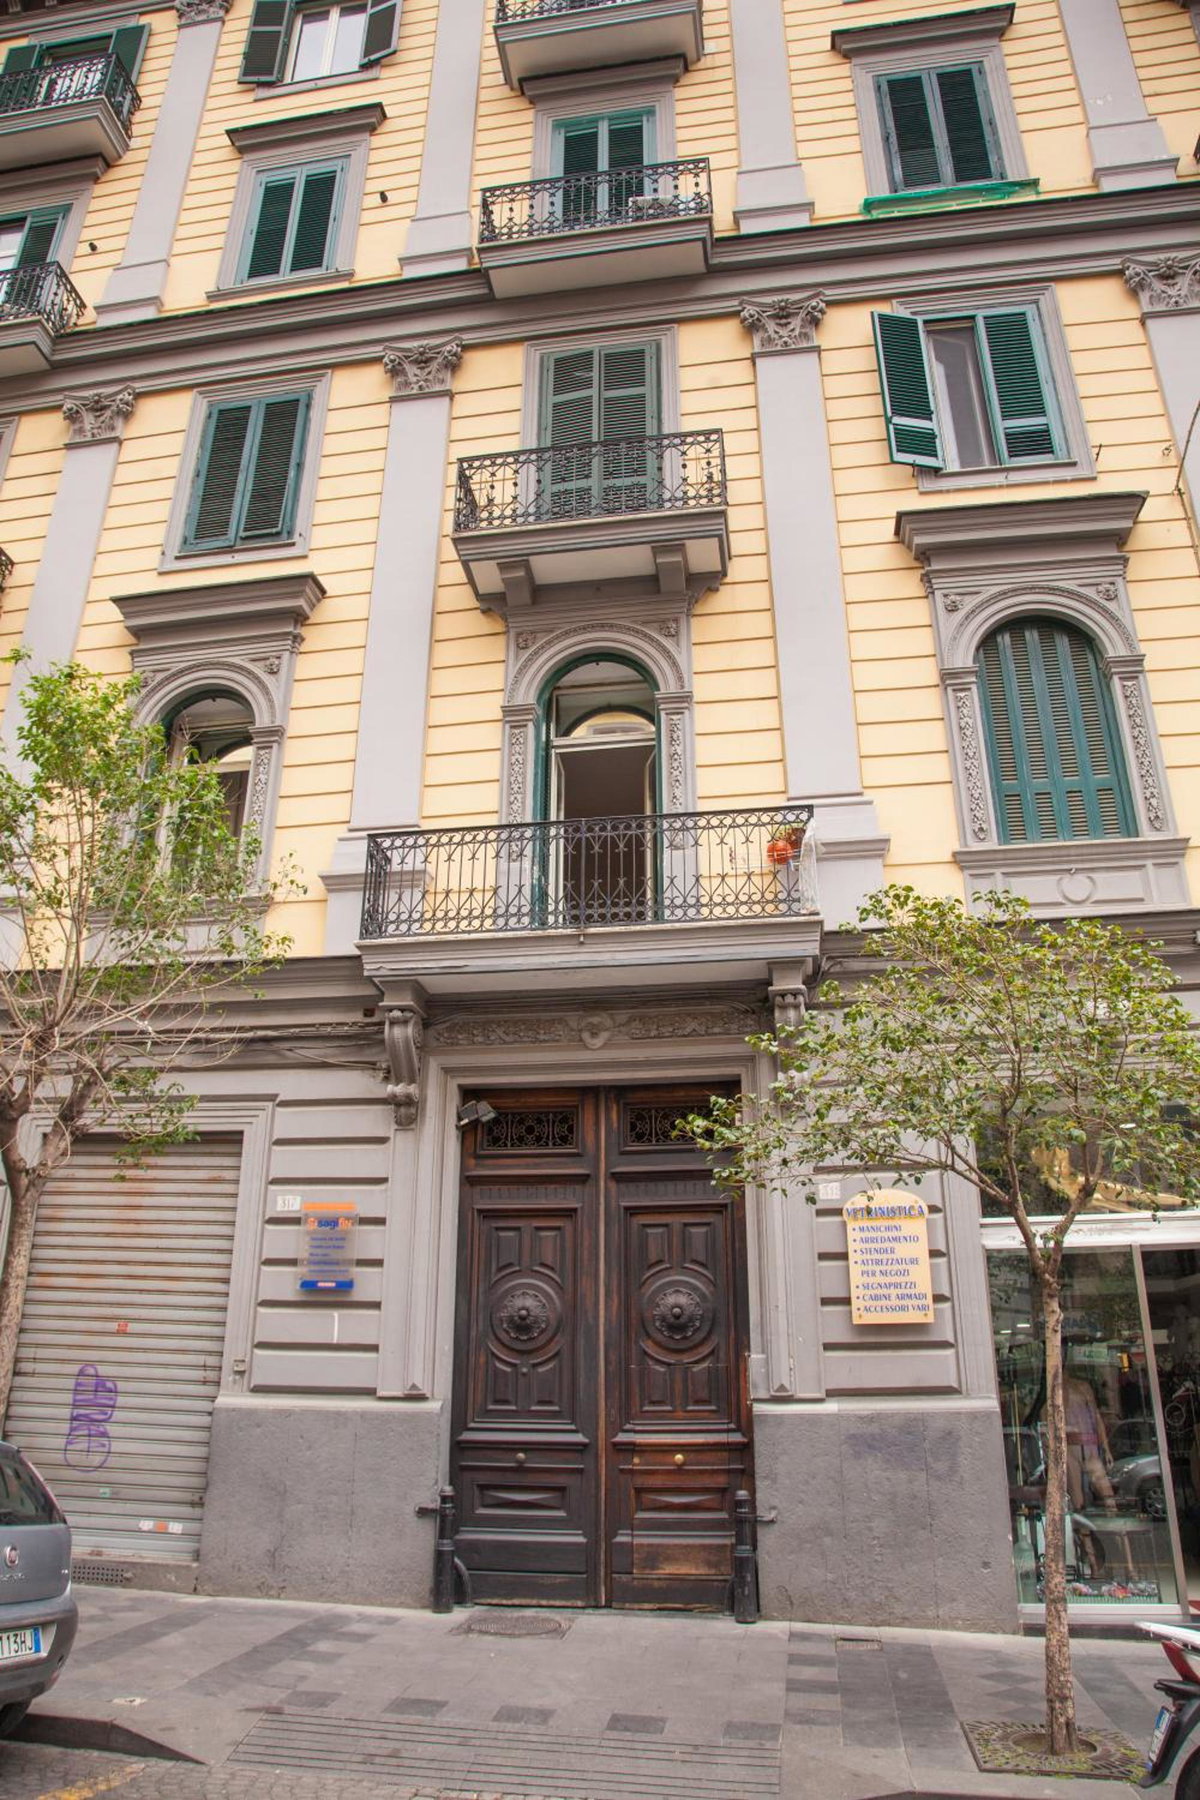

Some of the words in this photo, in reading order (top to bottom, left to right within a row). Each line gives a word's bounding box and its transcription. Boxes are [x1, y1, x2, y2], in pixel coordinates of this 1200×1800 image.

[846, 1205, 925, 1218] VETRINISTICA
[858, 1224, 902, 1233] MANICHINI
[859, 1235, 919, 1244] ARREDAMENTO
[860, 1246, 896, 1255] STENDER
[860, 1258, 920, 1266] ATTREZZATURE
[861, 1270, 877, 1278] PER
[880, 1269, 910, 1277] NEGOZI
[862, 1282, 917, 1291] SEGNAPREZZI
[862, 1294, 892, 1302] CABINE
[895, 1292, 927, 1301] ARMADI
[863, 1303, 909, 1313] ACCESSORI
[912, 1303, 930, 1311] VARI
